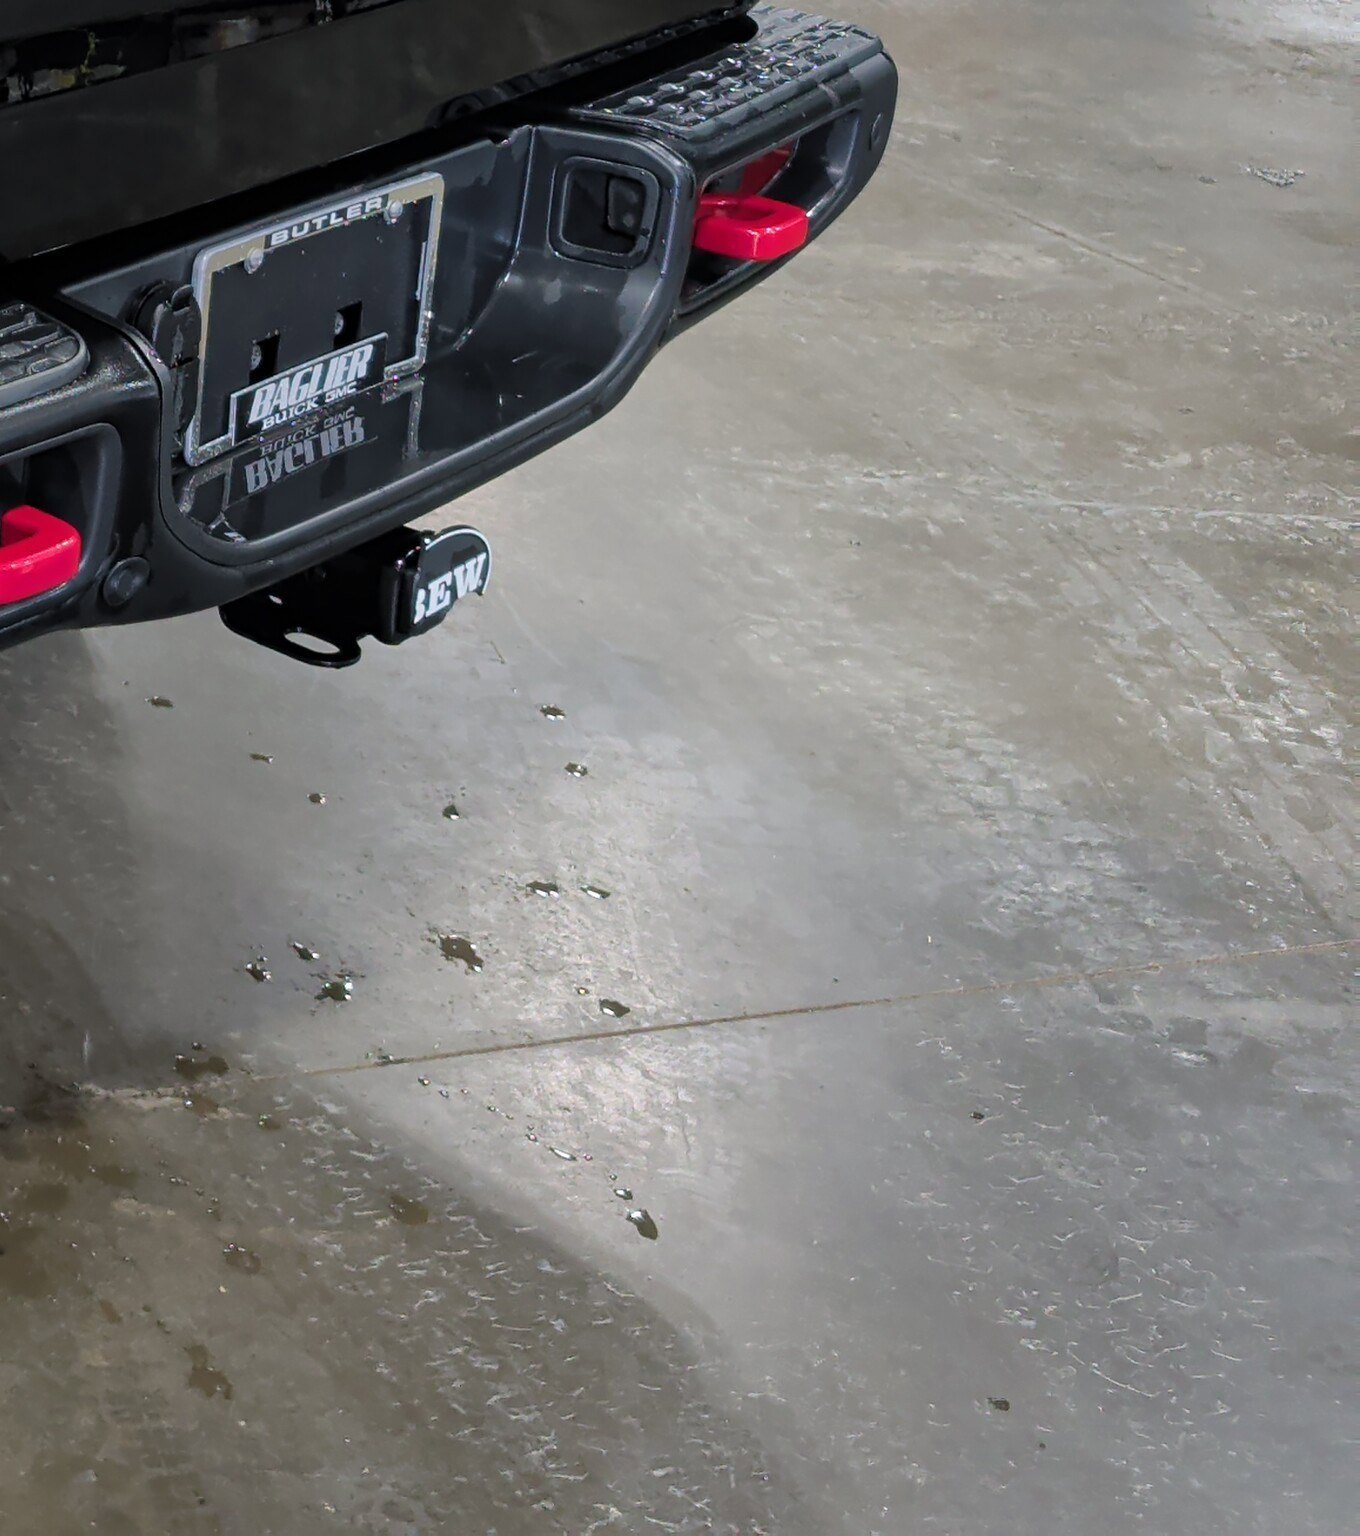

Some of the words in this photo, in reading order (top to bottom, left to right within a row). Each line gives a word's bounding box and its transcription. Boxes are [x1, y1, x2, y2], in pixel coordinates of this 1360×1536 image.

[270, 195, 382, 247] BUTLER
[249, 343, 375, 424] BAGLIER
[261, 395, 319, 432] BUICK
[325, 380, 358, 404] GMC
